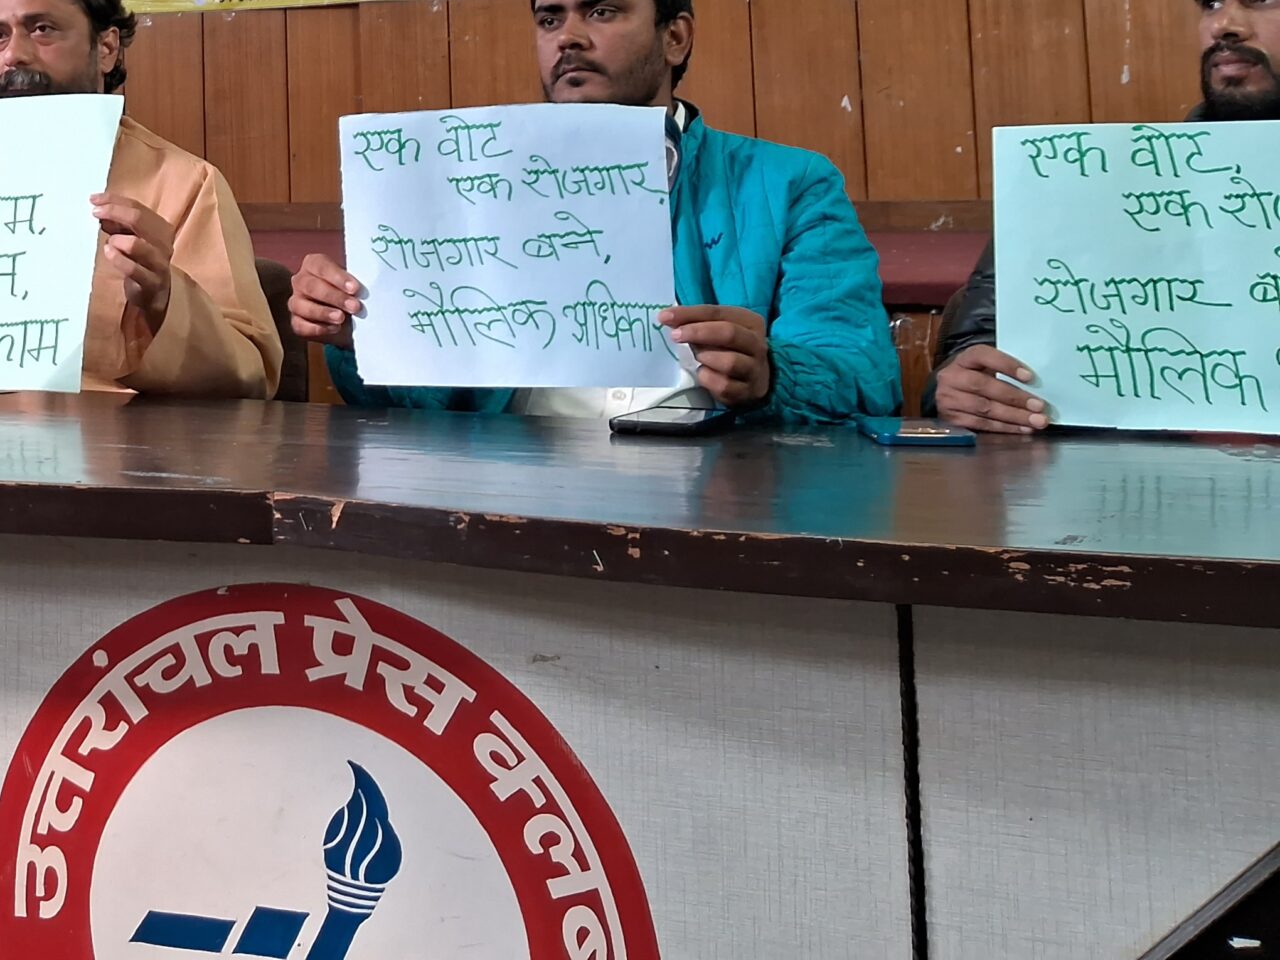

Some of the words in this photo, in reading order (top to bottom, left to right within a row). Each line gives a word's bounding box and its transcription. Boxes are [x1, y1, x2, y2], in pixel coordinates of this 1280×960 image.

[353, 127, 421, 172] एक
[437, 115, 513, 163] वोट
[1020, 131, 1109, 178] एक
[1131, 124, 1242, 178] वोट,
[447, 172, 512, 205] एक
[1122, 189, 1214, 233] एक
[370, 224, 519, 272] रोजगार
[403, 281, 556, 350] मौलिक
[1033, 258, 1234, 316] रोजगार
[1076, 317, 1269, 413] मौलिक
[14, 609, 287, 919] उत्तरांचल
[303, 597, 477, 737] प्रेस
